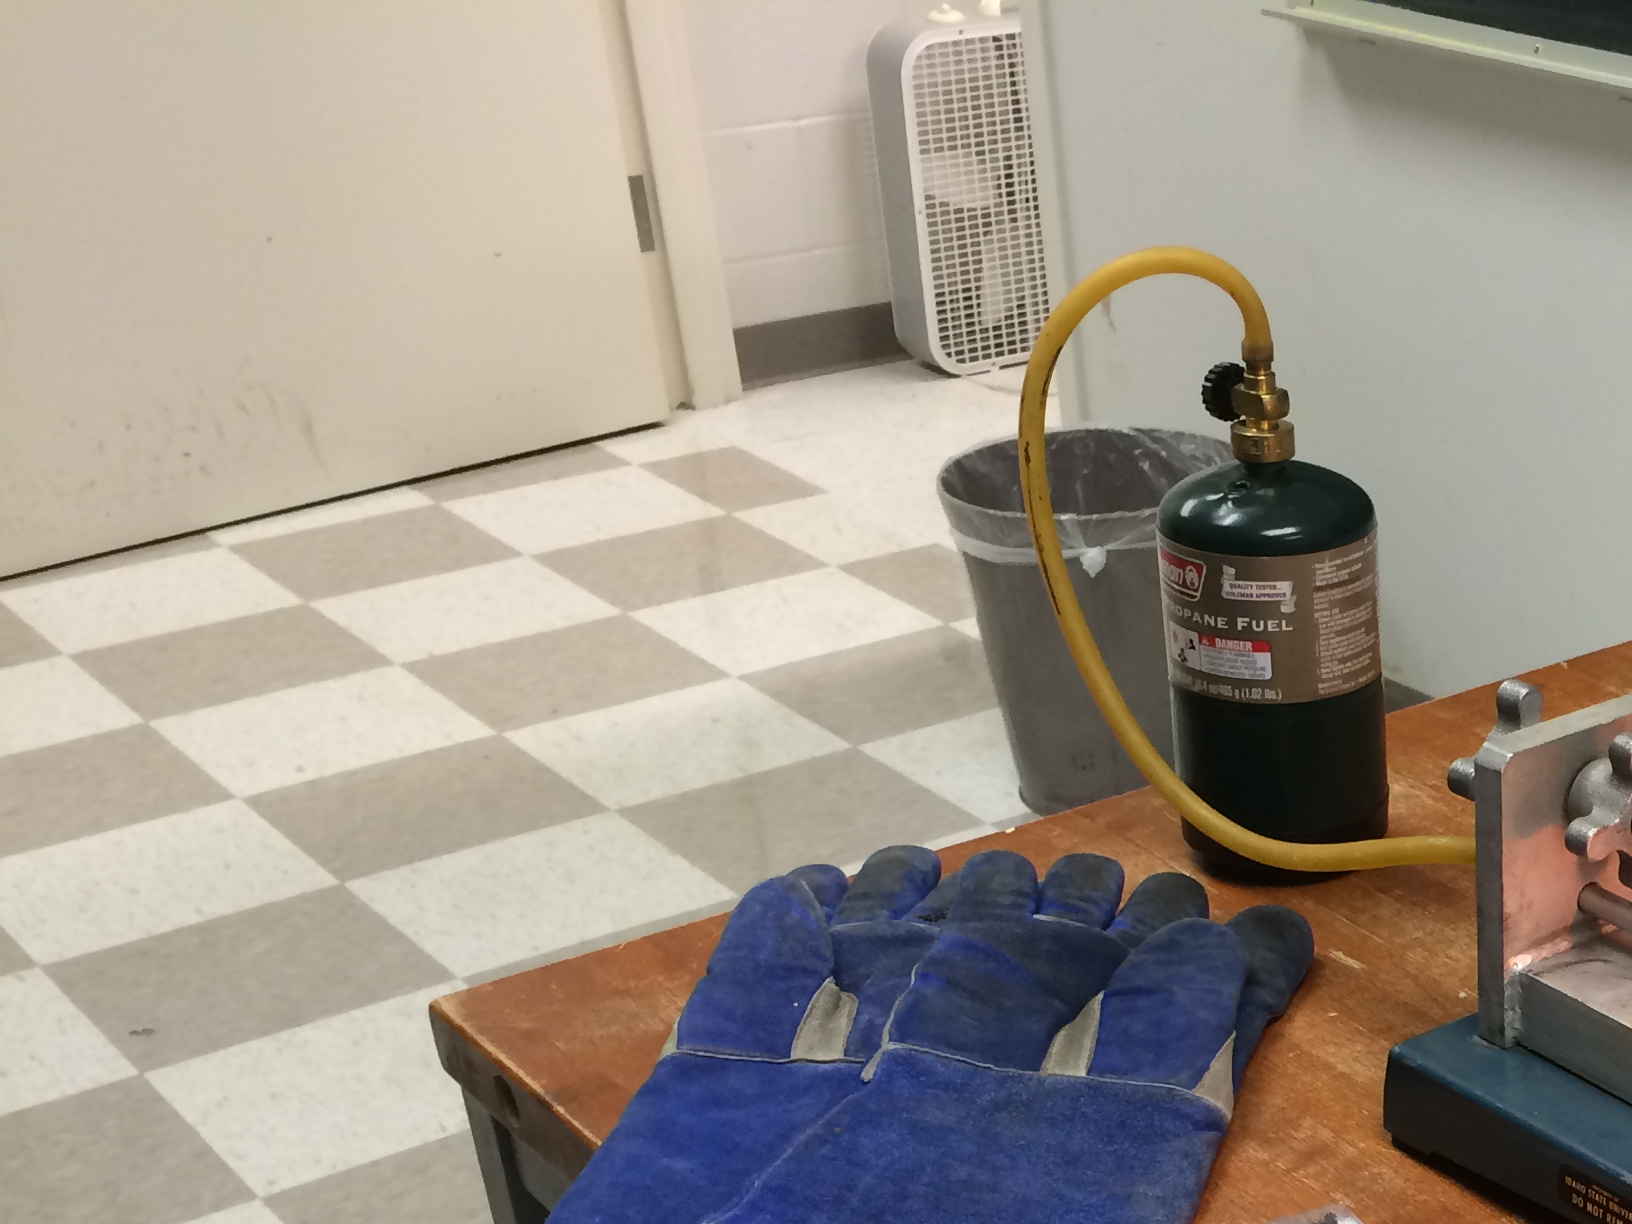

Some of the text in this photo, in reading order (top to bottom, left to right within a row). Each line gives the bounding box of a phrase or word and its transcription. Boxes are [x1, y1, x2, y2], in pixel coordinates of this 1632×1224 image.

[1237, 617, 1293, 632] FUEL
[1215, 637, 1253, 652] DANGER
[1565, 1175, 1586, 1194] IDAHO
[1588, 1189, 1607, 1207] STATE
[1572, 1193, 1584, 1208] DO
[1586, 1201, 1604, 1219] NOT
